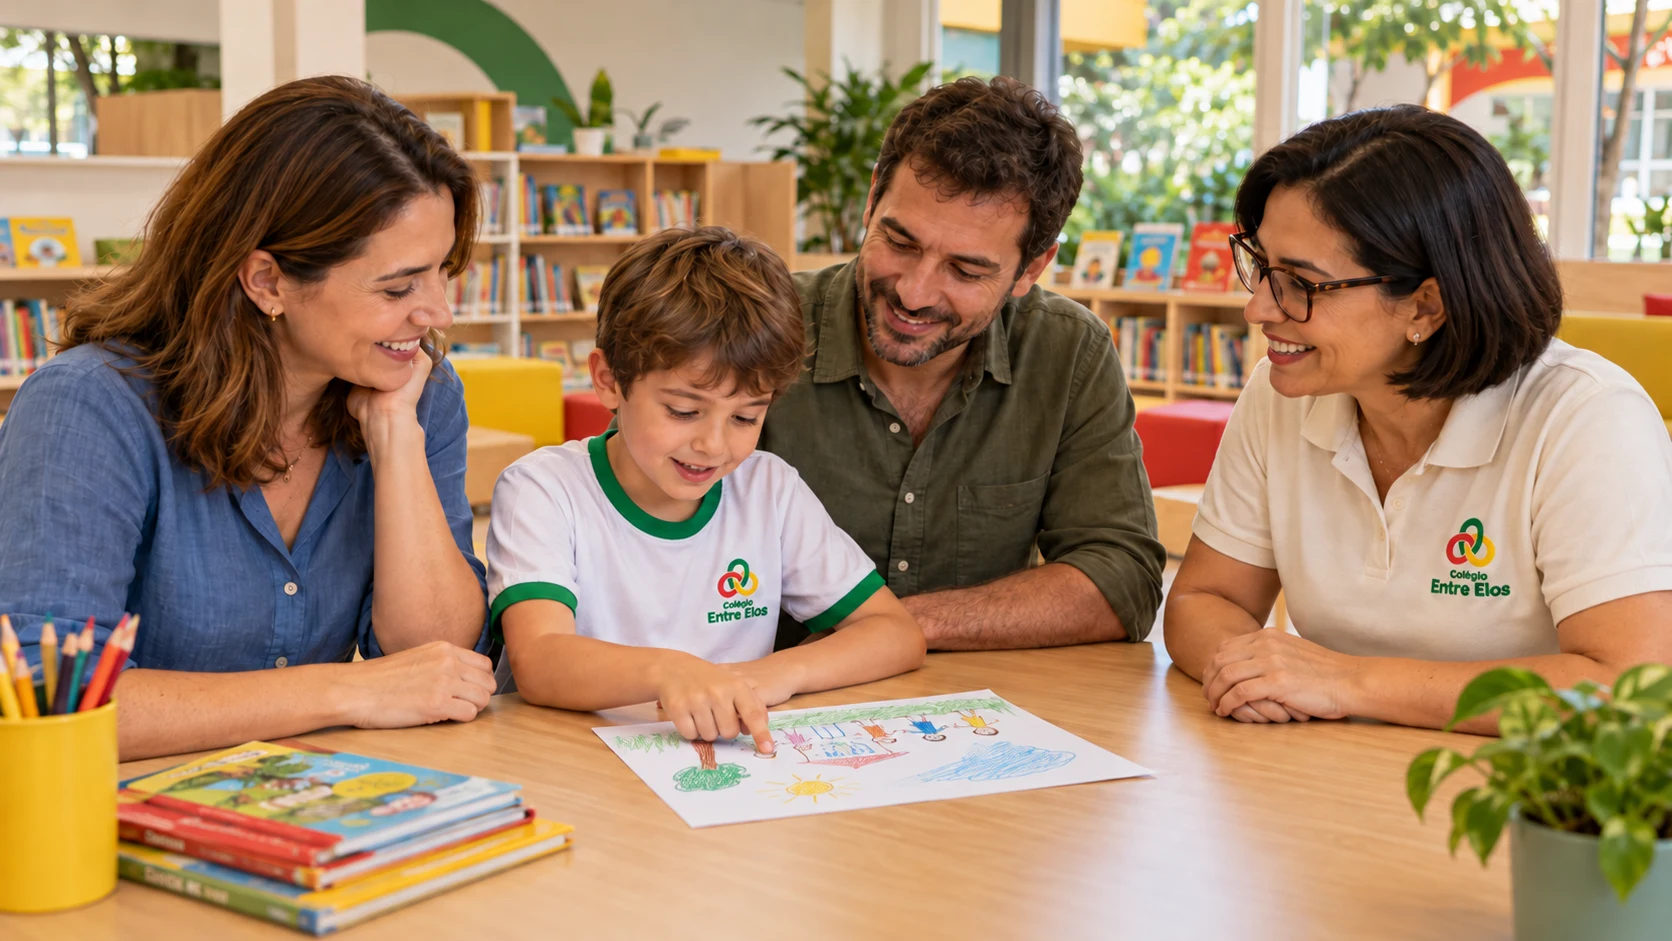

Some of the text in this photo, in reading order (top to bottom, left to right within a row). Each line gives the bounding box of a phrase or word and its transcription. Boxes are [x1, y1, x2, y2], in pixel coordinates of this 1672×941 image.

[1450, 570, 1488, 582] Colégio
[1431, 578, 1511, 597] Entre Elos
[707, 606, 768, 623] Entre Elos
